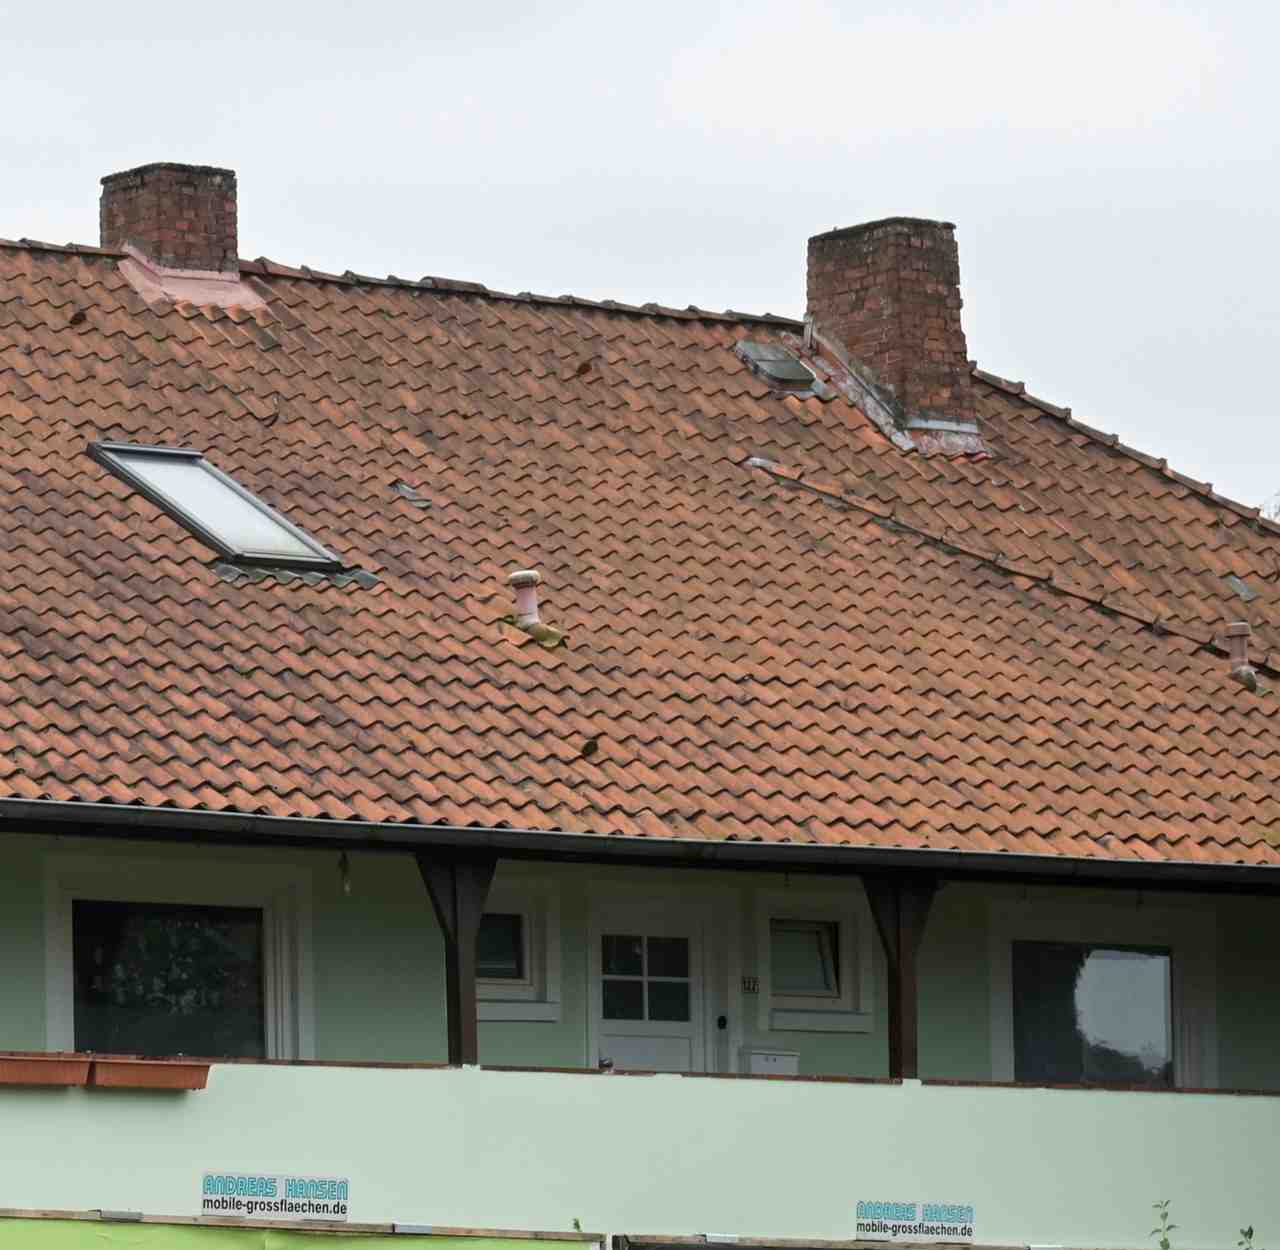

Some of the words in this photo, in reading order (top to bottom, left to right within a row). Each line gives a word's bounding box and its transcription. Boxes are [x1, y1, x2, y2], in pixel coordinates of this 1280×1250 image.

[203, 1175, 277, 1198] ANDREAS
[285, 1178, 348, 1200] HANSEN
[203, 1196, 347, 1215] mobile-grossflaechen.de
[856, 1220, 973, 1237] mobile-grossflaechen.de
